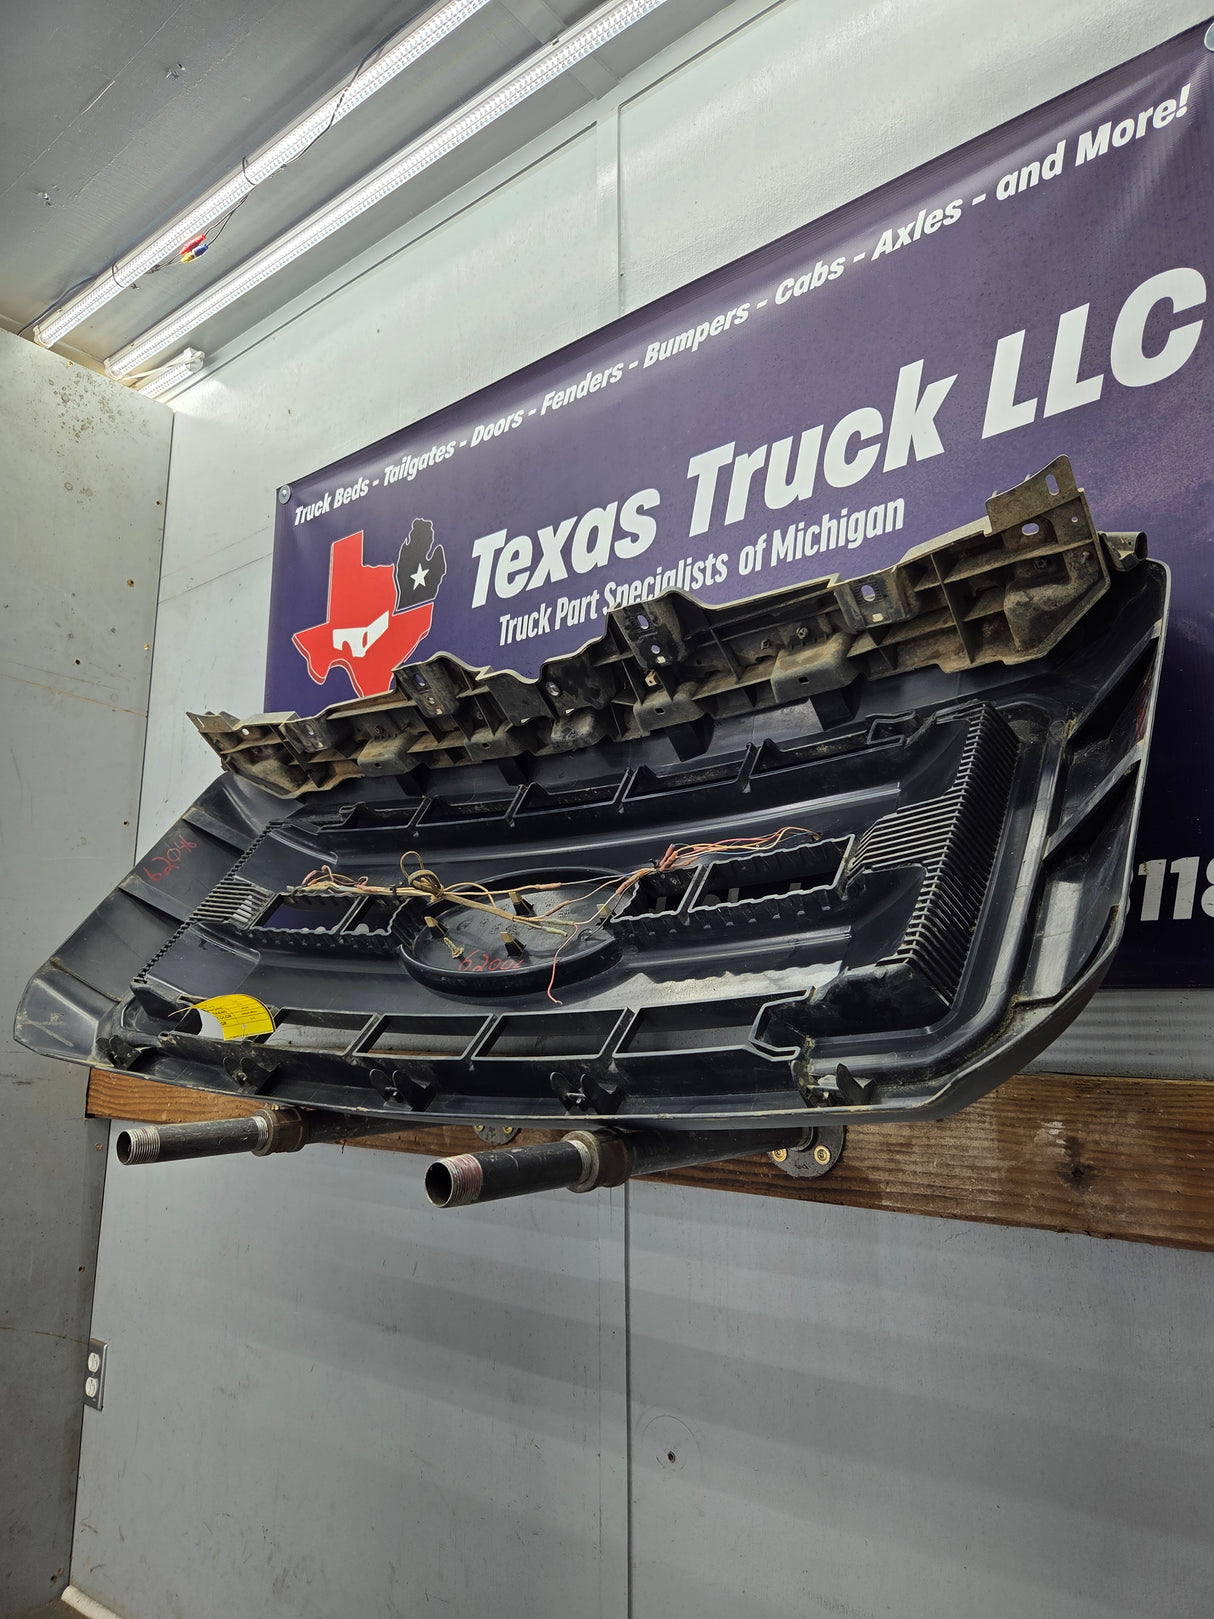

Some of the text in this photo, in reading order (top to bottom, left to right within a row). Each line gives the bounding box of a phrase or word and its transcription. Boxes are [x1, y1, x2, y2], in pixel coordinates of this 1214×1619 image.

[294, 491, 332, 527] Truck
[333, 476, 370, 510] Beds
[383, 440, 456, 487] Tailgates
[470, 408, 524, 449] Doors
[540, 363, 624, 416] Fenders
[643, 302, 751, 369] Bumpers
[774, 257, 846, 305] Cabs
[871, 199, 964, 261] Axles
[996, 140, 1067, 201] and
[1075, 82, 1192, 167] More!
[471, 267, 1207, 608] Texas Truck LLC
[499, 603, 552, 647] Truck
[554, 589, 600, 631] Part
[738, 533, 768, 576] of
[770, 497, 905, 569] Michigan
[143, 834, 198, 882] 62046
